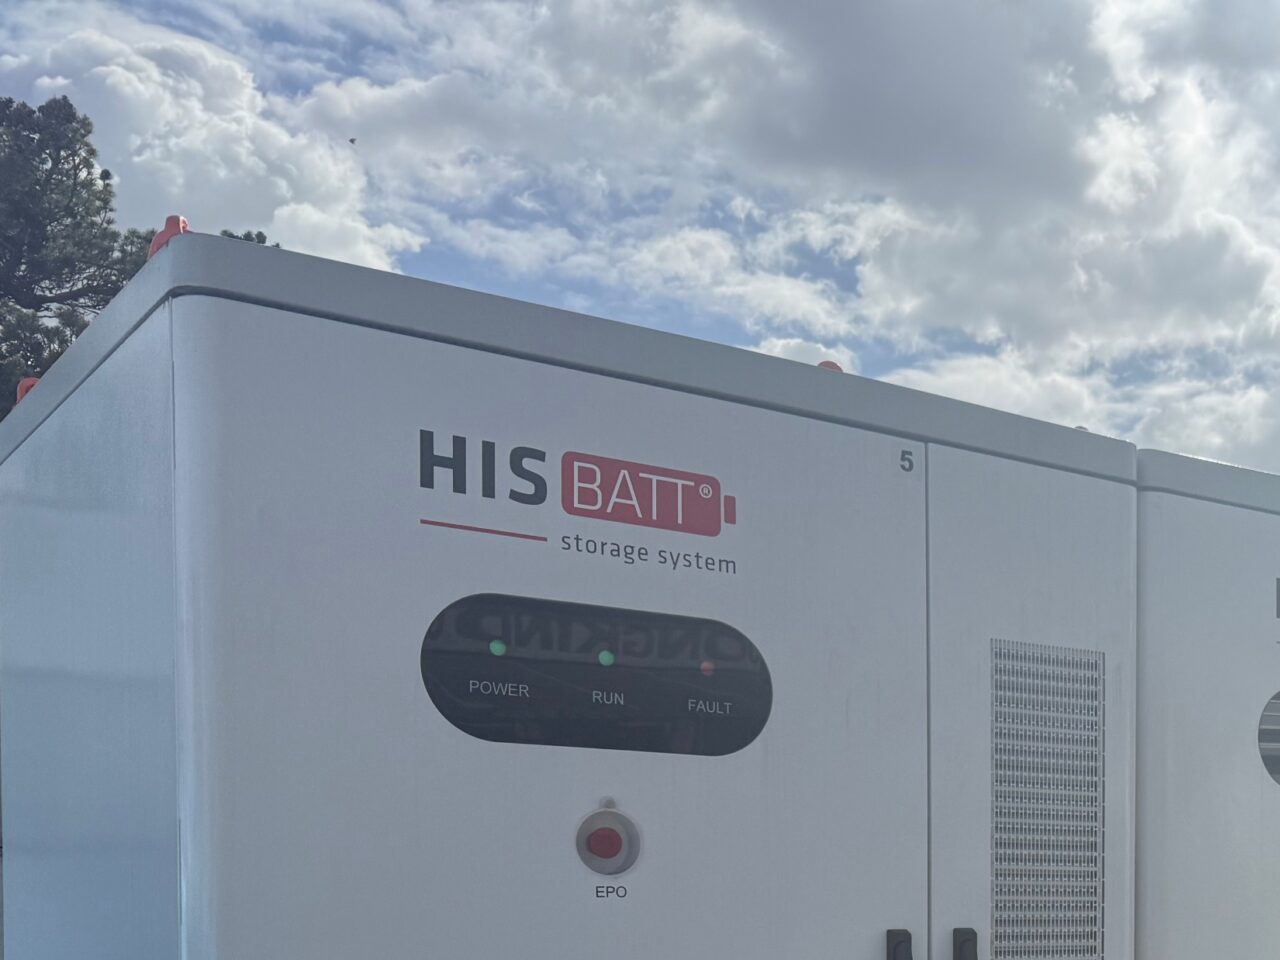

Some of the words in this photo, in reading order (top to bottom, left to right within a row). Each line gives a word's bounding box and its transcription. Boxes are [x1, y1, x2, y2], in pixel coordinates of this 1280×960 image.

[419, 429, 548, 506] HIS
[899, 450, 915, 473] 5
[561, 533, 649, 565] storage
[657, 548, 738, 575] system
[469, 680, 530, 699] POWER
[592, 690, 625, 707] RUN
[687, 699, 733, 715] FAULT
[595, 885, 627, 899] EPO
